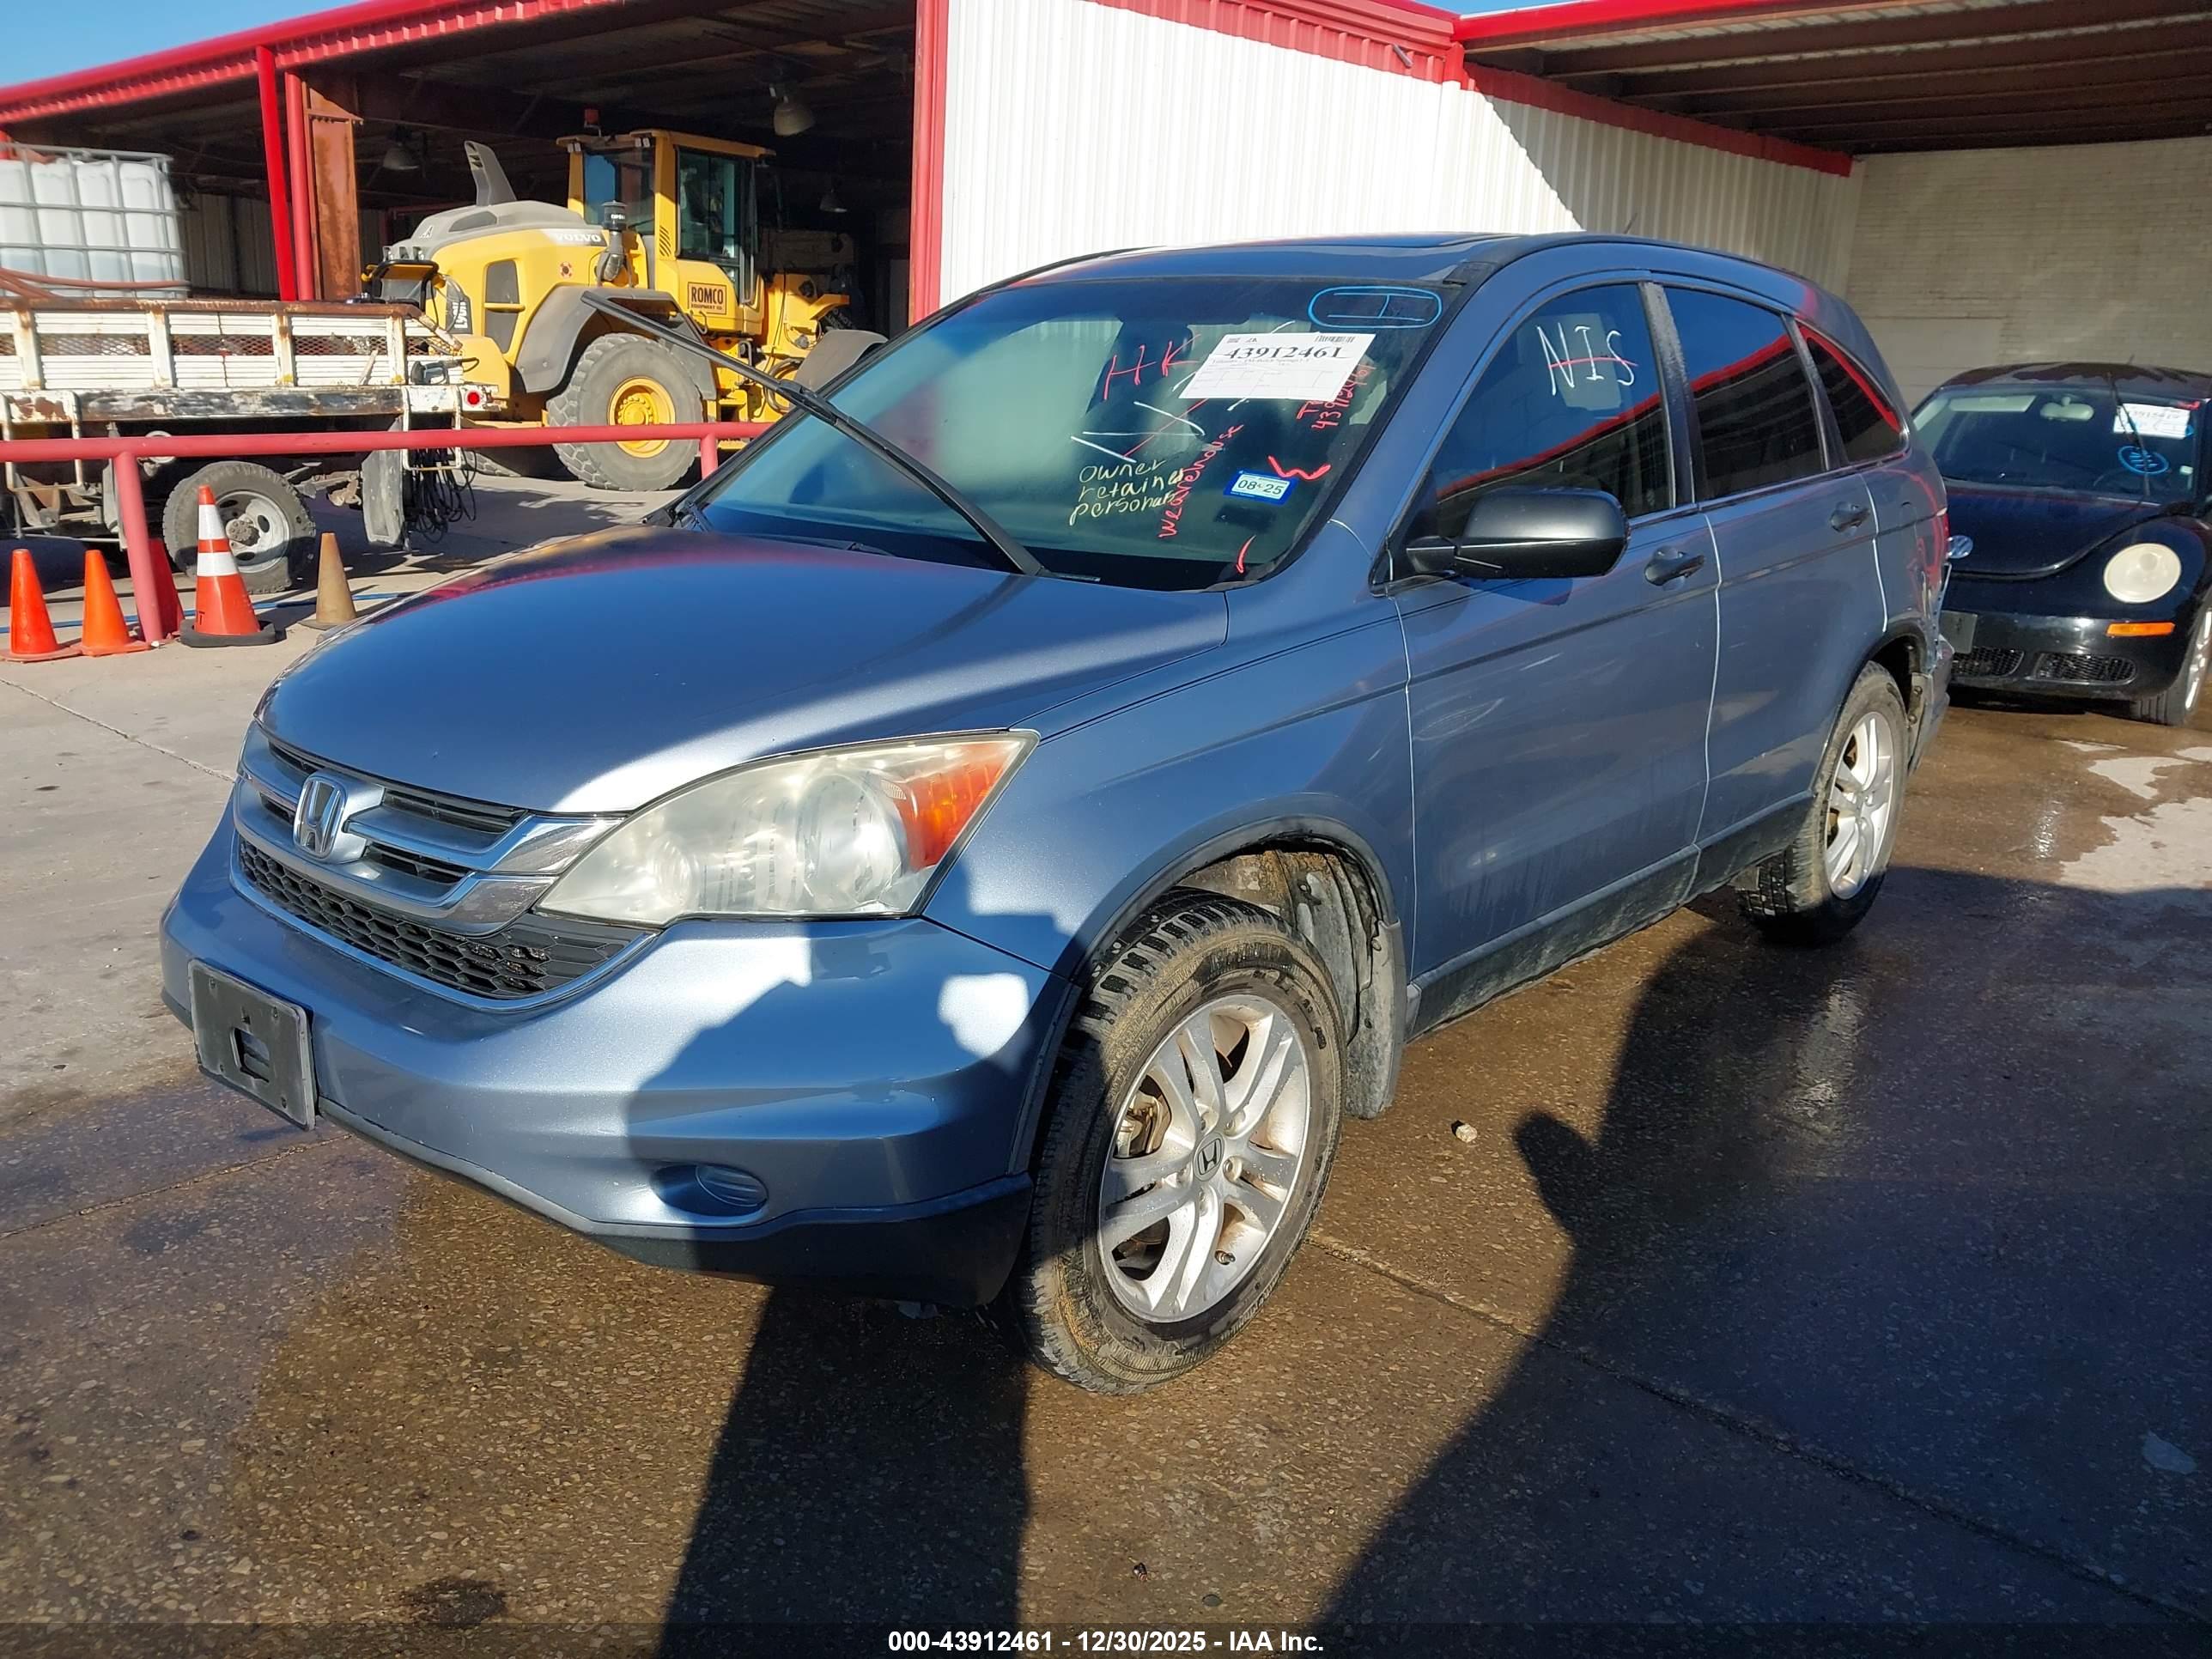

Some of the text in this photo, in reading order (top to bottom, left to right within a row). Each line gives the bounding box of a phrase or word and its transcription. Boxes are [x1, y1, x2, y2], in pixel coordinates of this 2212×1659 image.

[691, 286, 723, 305] ROMCO
[1223, 346, 1343, 360] 43912461
[1534, 322, 1635, 396] NIS
[1237, 479, 1258, 491] 08
[1263, 483, 1285, 495] 25
